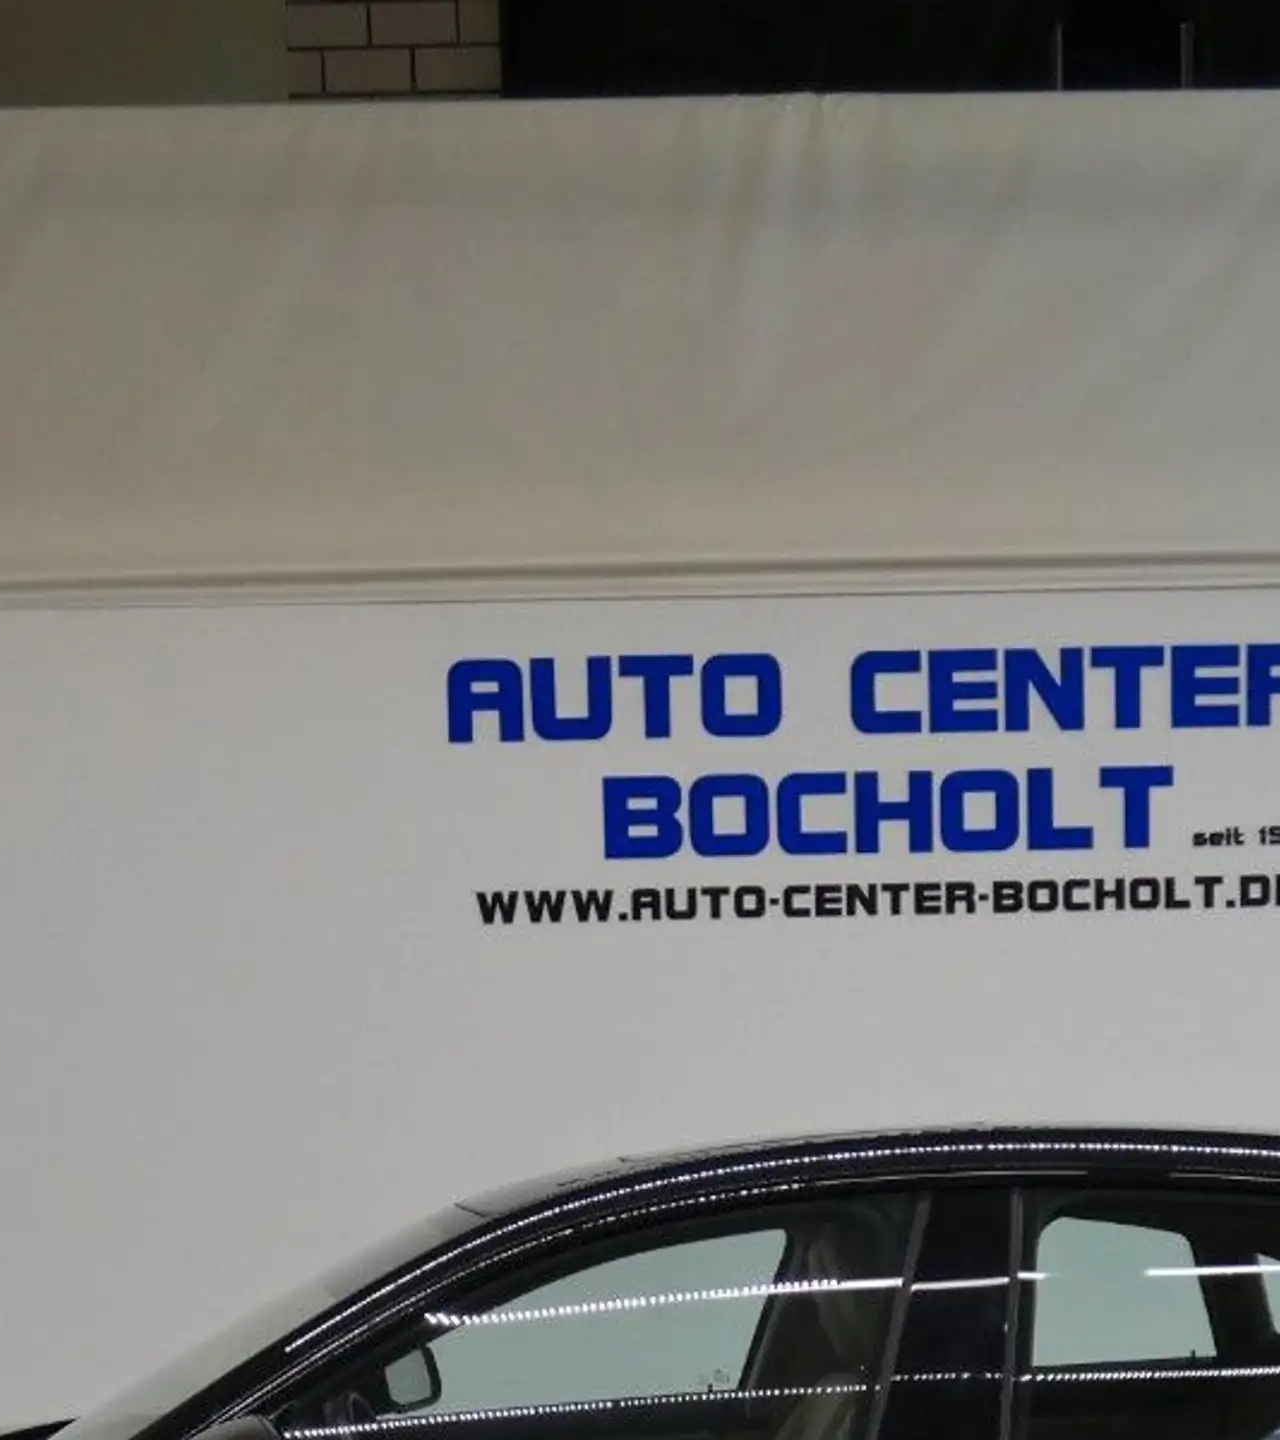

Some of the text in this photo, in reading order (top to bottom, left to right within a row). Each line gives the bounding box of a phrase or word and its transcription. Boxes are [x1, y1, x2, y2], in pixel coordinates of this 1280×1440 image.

[447, 653, 782, 744] AUTO
[602, 765, 1174, 860] BOCHOLT
[1192, 826, 1245, 847] seit
